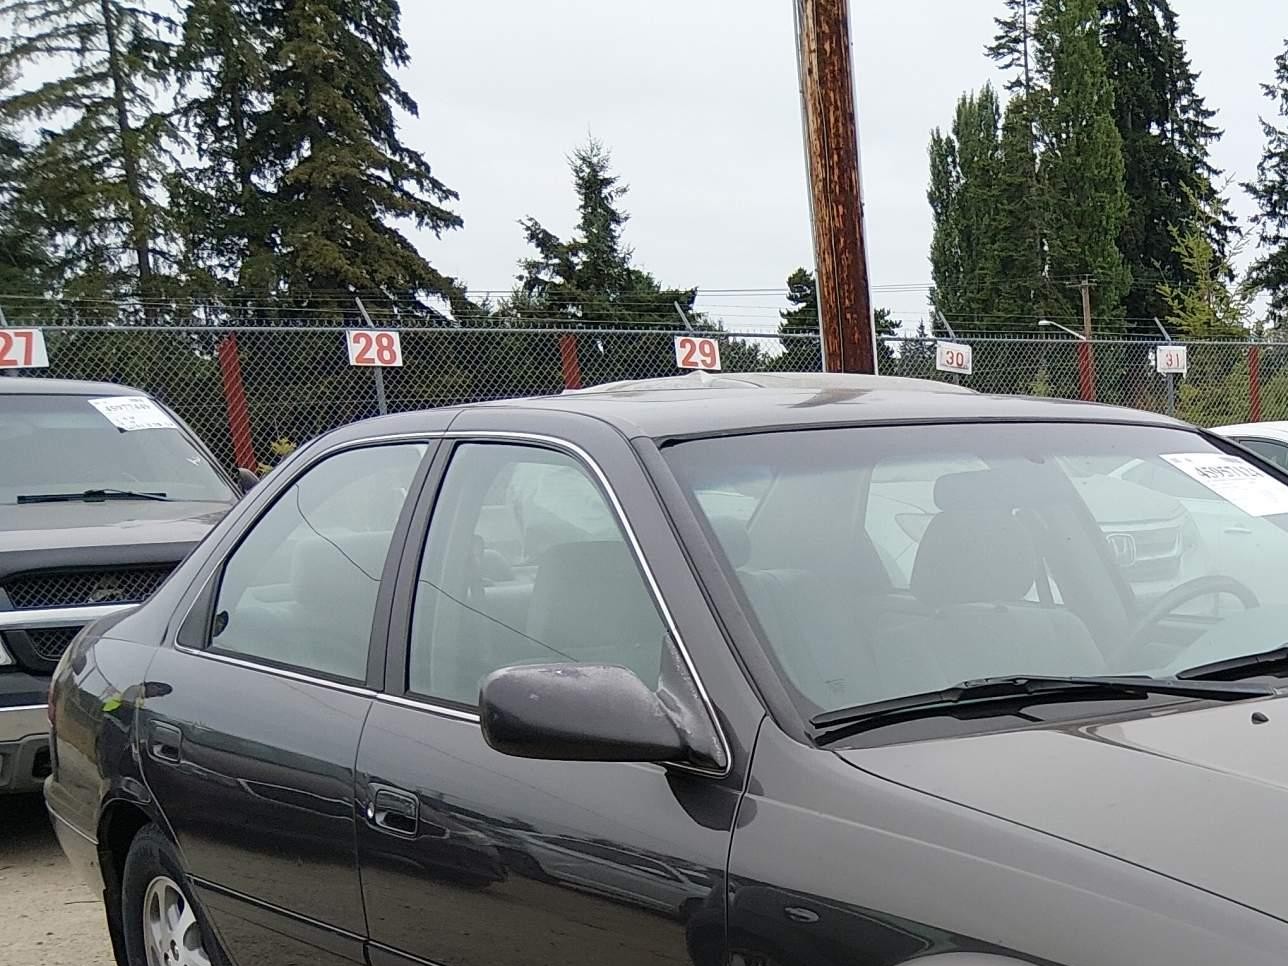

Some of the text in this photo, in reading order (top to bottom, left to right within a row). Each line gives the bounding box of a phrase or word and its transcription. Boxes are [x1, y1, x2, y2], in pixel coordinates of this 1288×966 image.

[0, 332, 33, 366] 27
[353, 332, 397, 365] 28
[680, 338, 717, 369] 29
[946, 350, 964, 367] 30
[1166, 353, 1180, 368] 31
